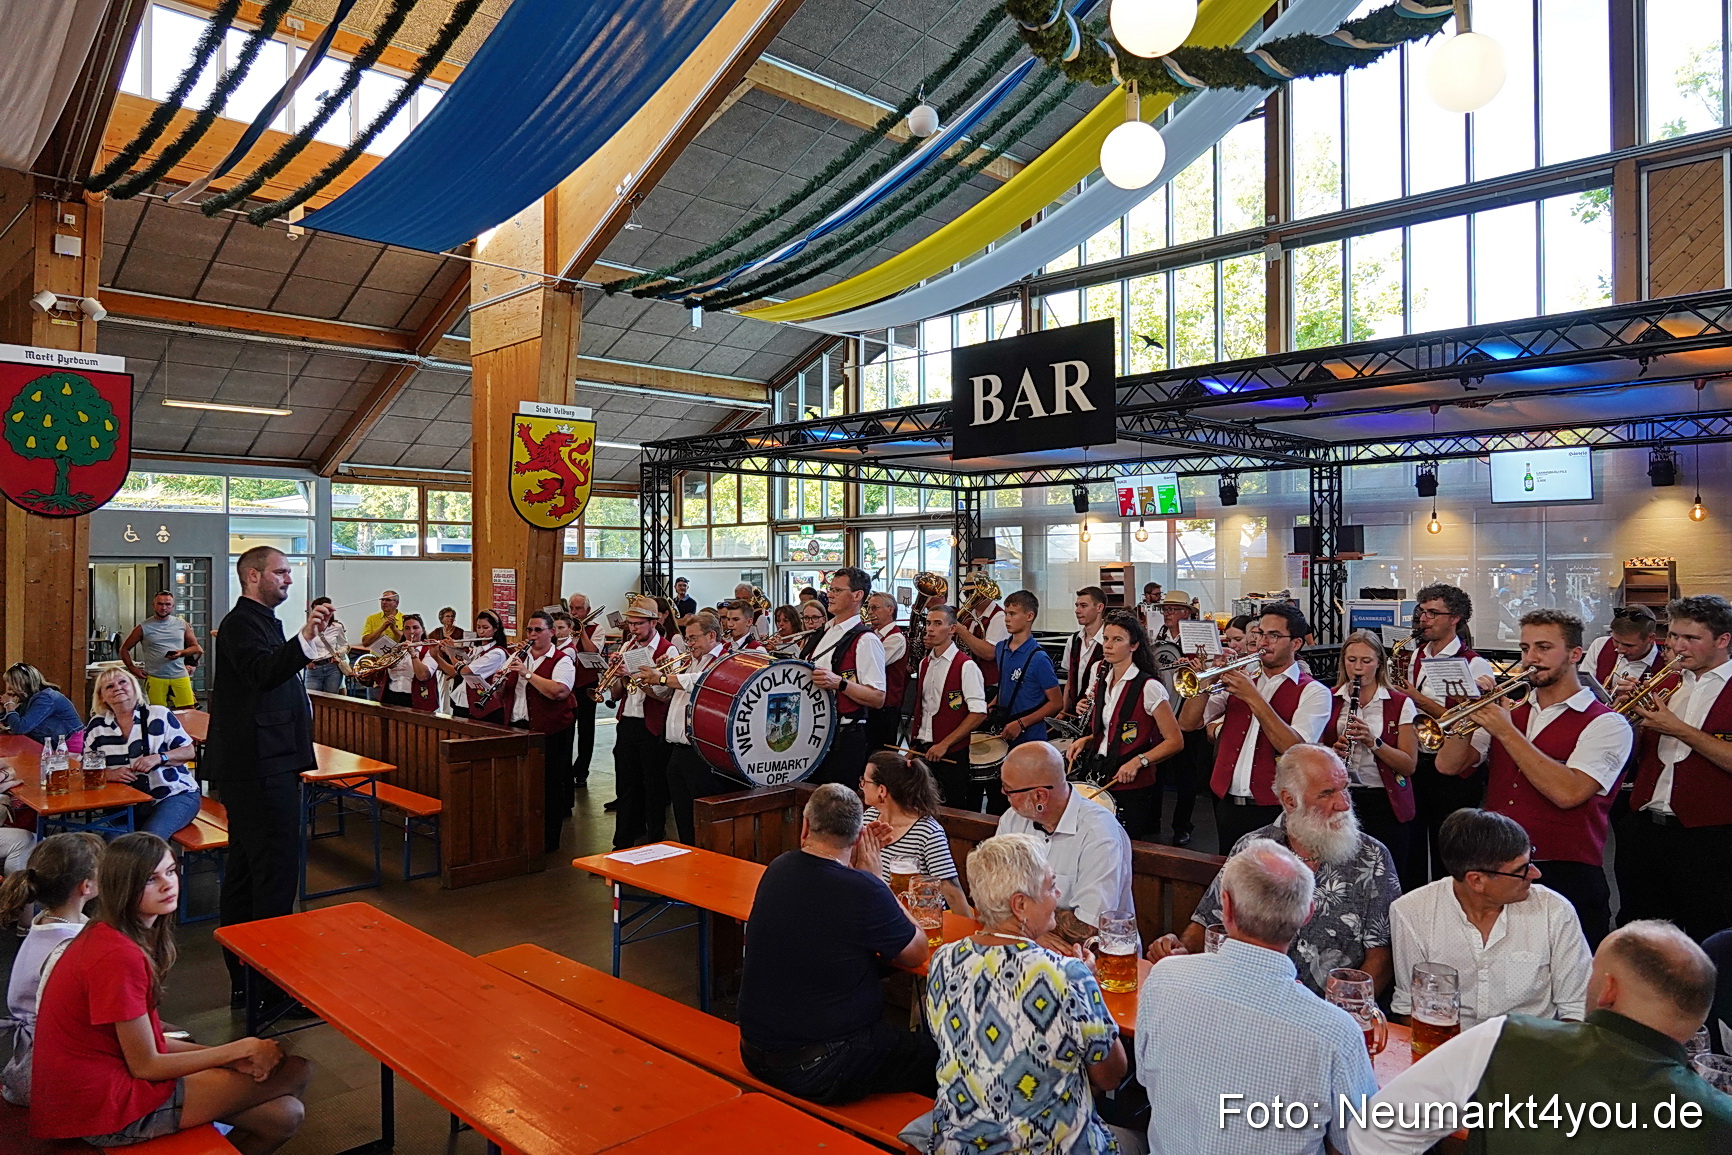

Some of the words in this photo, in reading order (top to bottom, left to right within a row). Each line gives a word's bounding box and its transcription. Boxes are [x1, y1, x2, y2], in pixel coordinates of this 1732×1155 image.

[25, 350, 54, 361] Markt
[57, 353, 99, 366] Pyrbaum
[969, 360, 1097, 426] BAR
[535, 405, 552, 414] Stadt
[736, 668, 826, 757] WERKVOLKKAPELLE
[747, 757, 810, 775] NEUMARKT
[766, 772, 790, 785] OPF.
